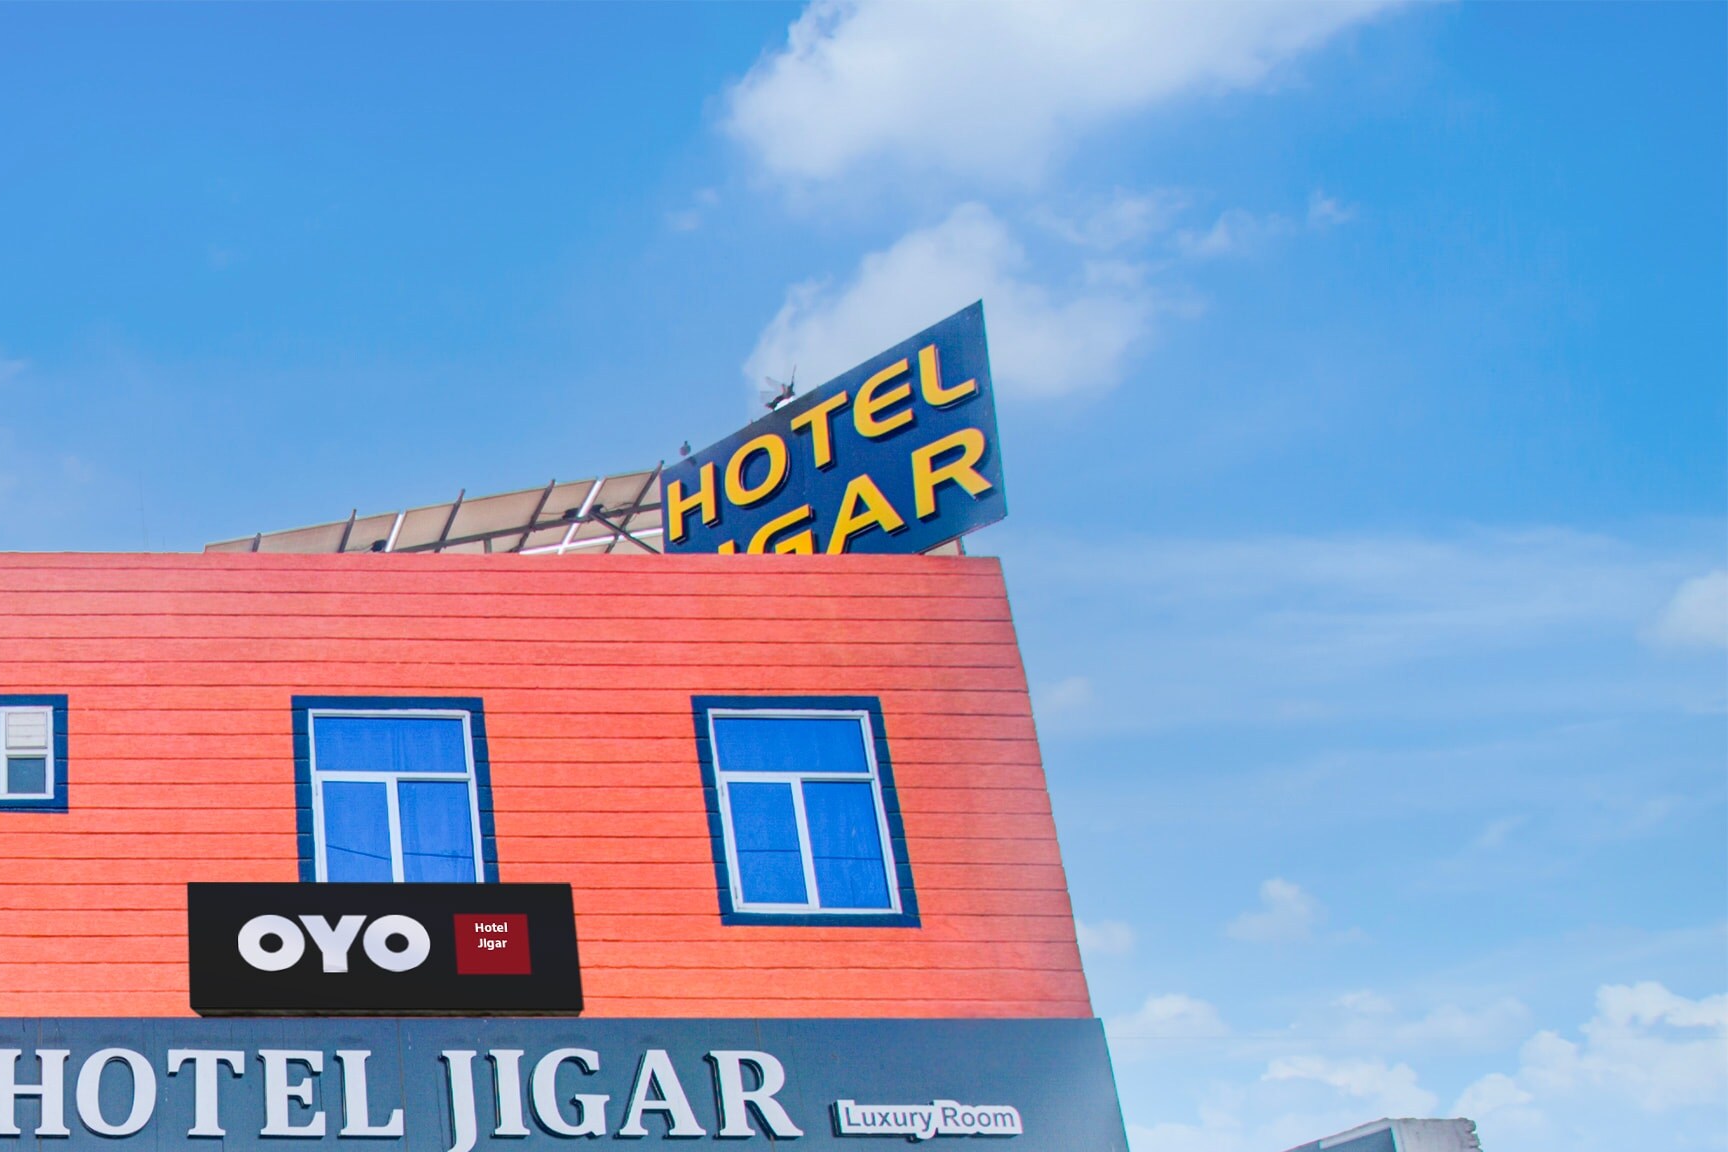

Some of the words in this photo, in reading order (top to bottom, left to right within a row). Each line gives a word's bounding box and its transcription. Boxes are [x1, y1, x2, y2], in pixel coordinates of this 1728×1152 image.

[667, 343, 978, 542] HOTEL
[718, 427, 992, 553] GAR
[238, 914, 431, 973] OYO
[474, 921, 509, 934] Hotel
[844, 1105, 932, 1132] Luxury
[941, 1105, 1015, 1128] Room
